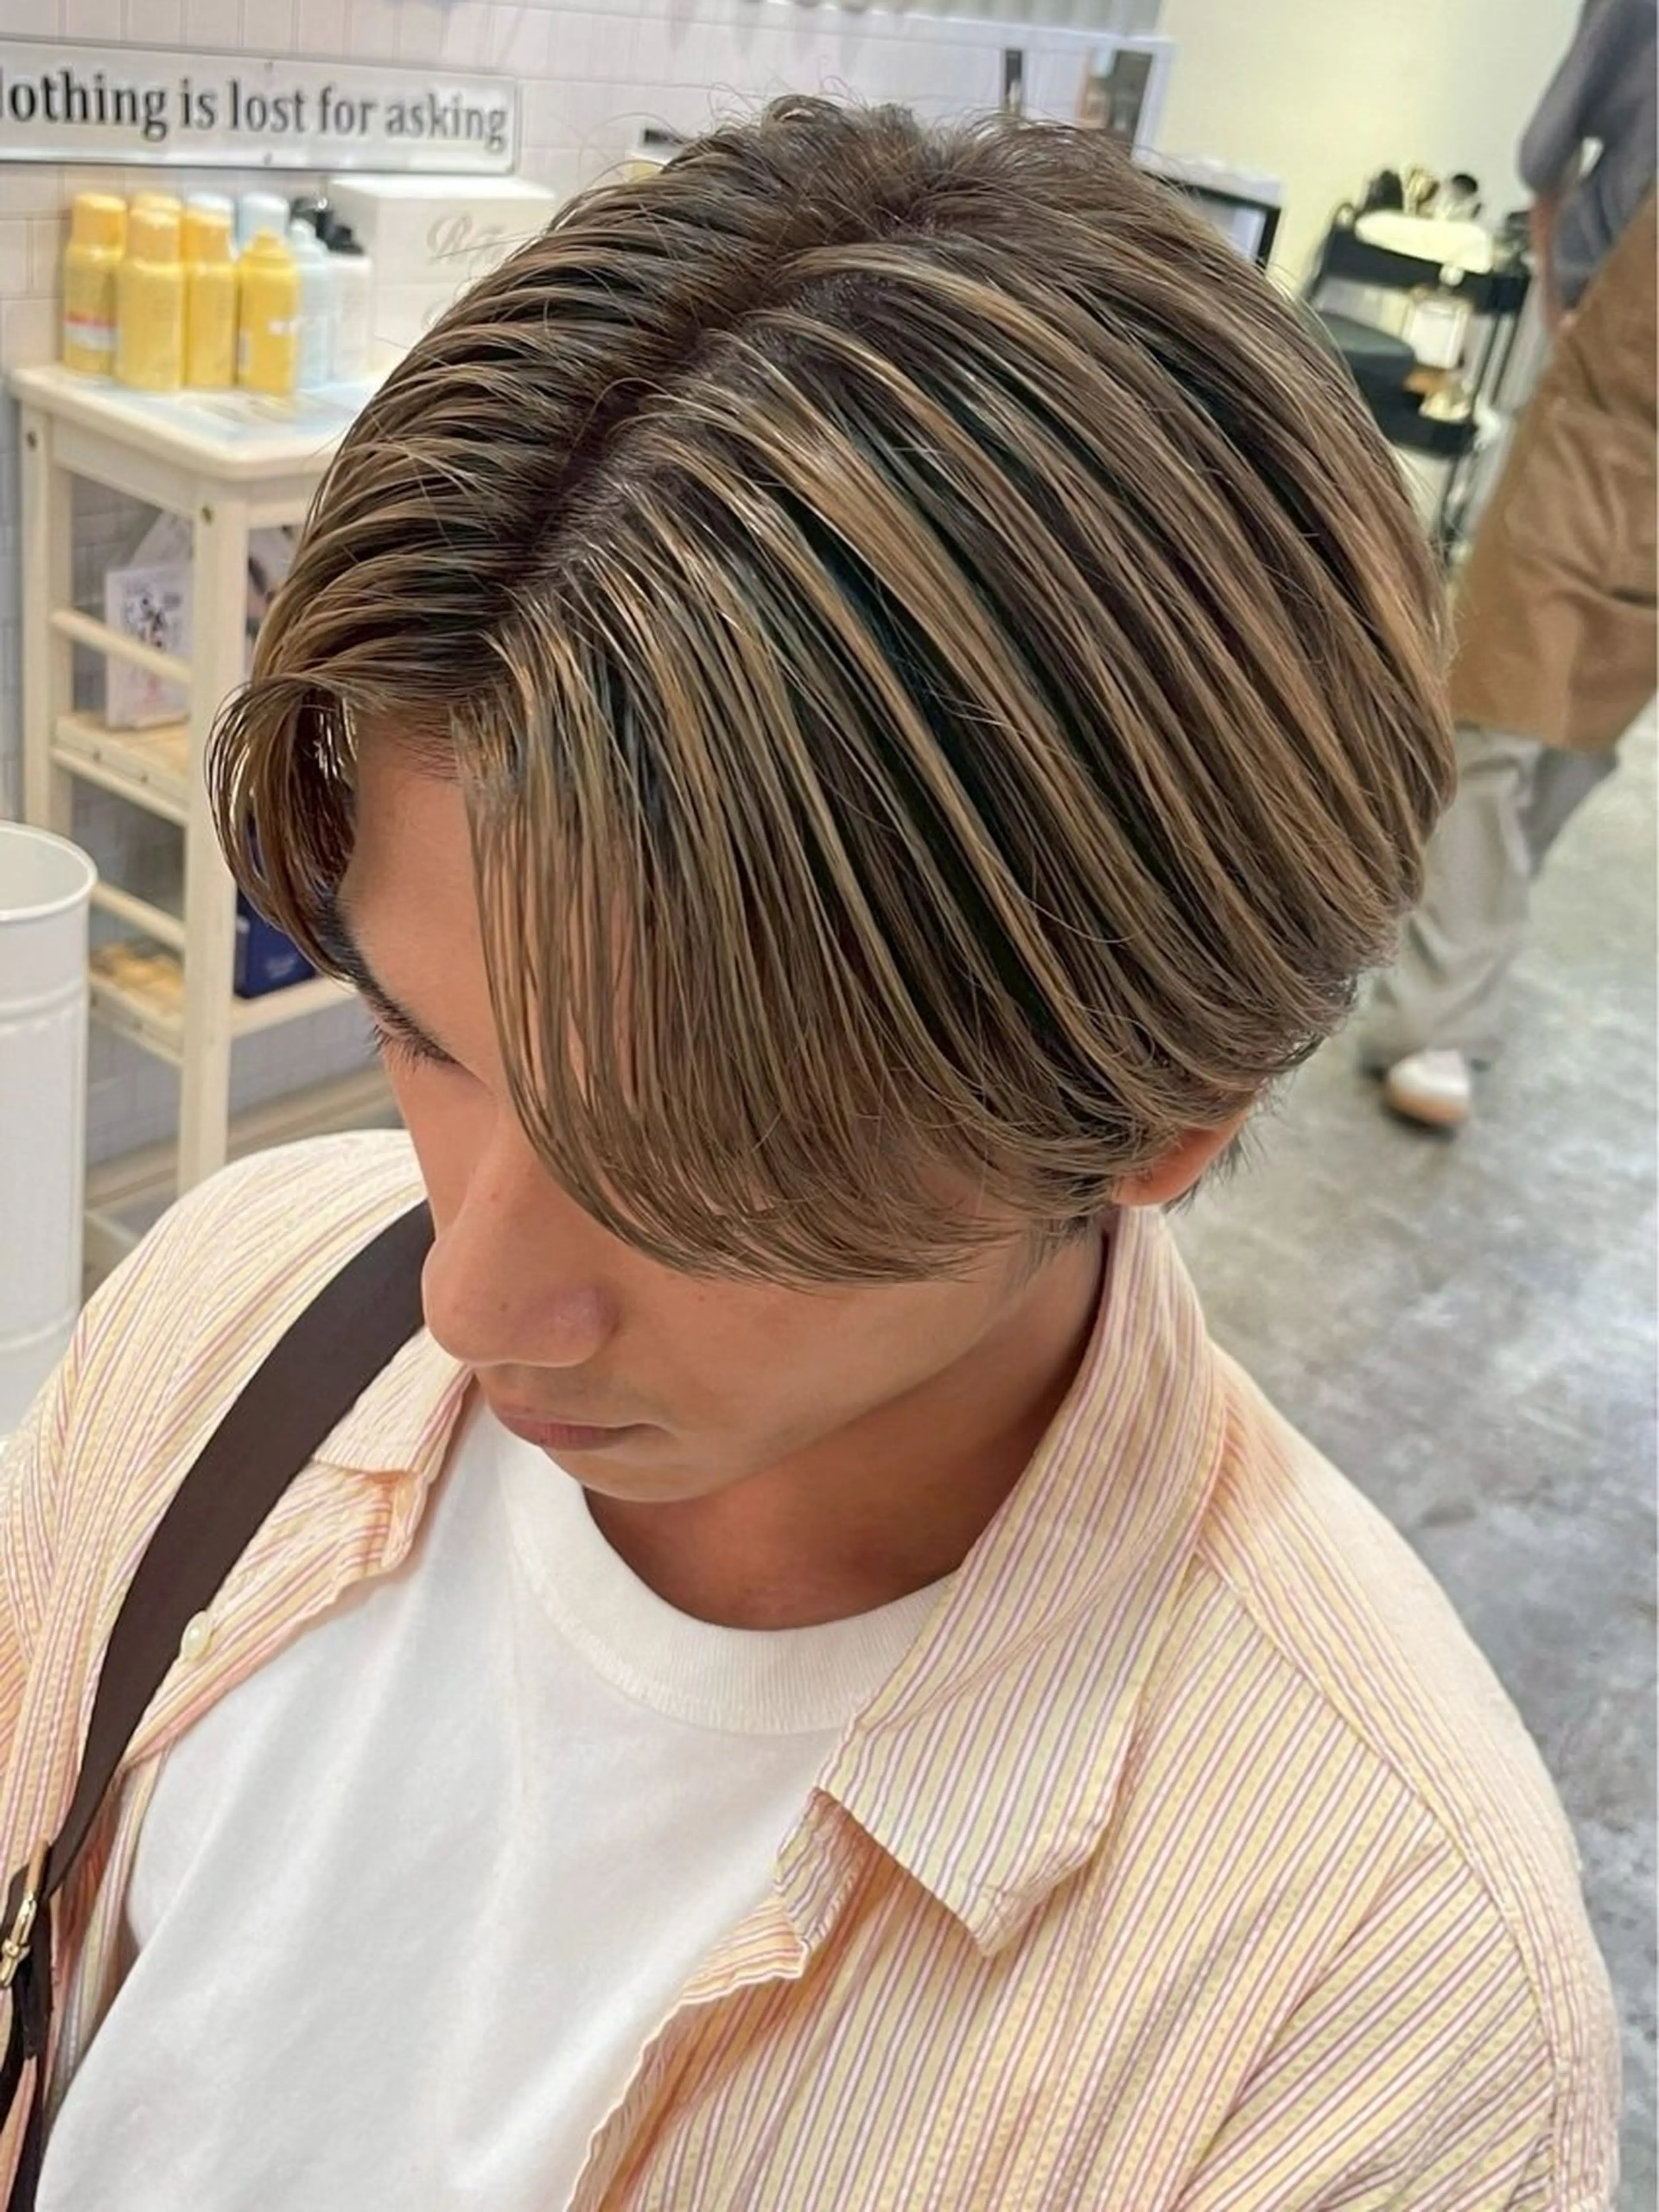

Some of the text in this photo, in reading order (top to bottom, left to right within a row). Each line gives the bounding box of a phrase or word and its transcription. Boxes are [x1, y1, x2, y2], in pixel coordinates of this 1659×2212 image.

[0, 66, 506, 155] othing is lost for asking
